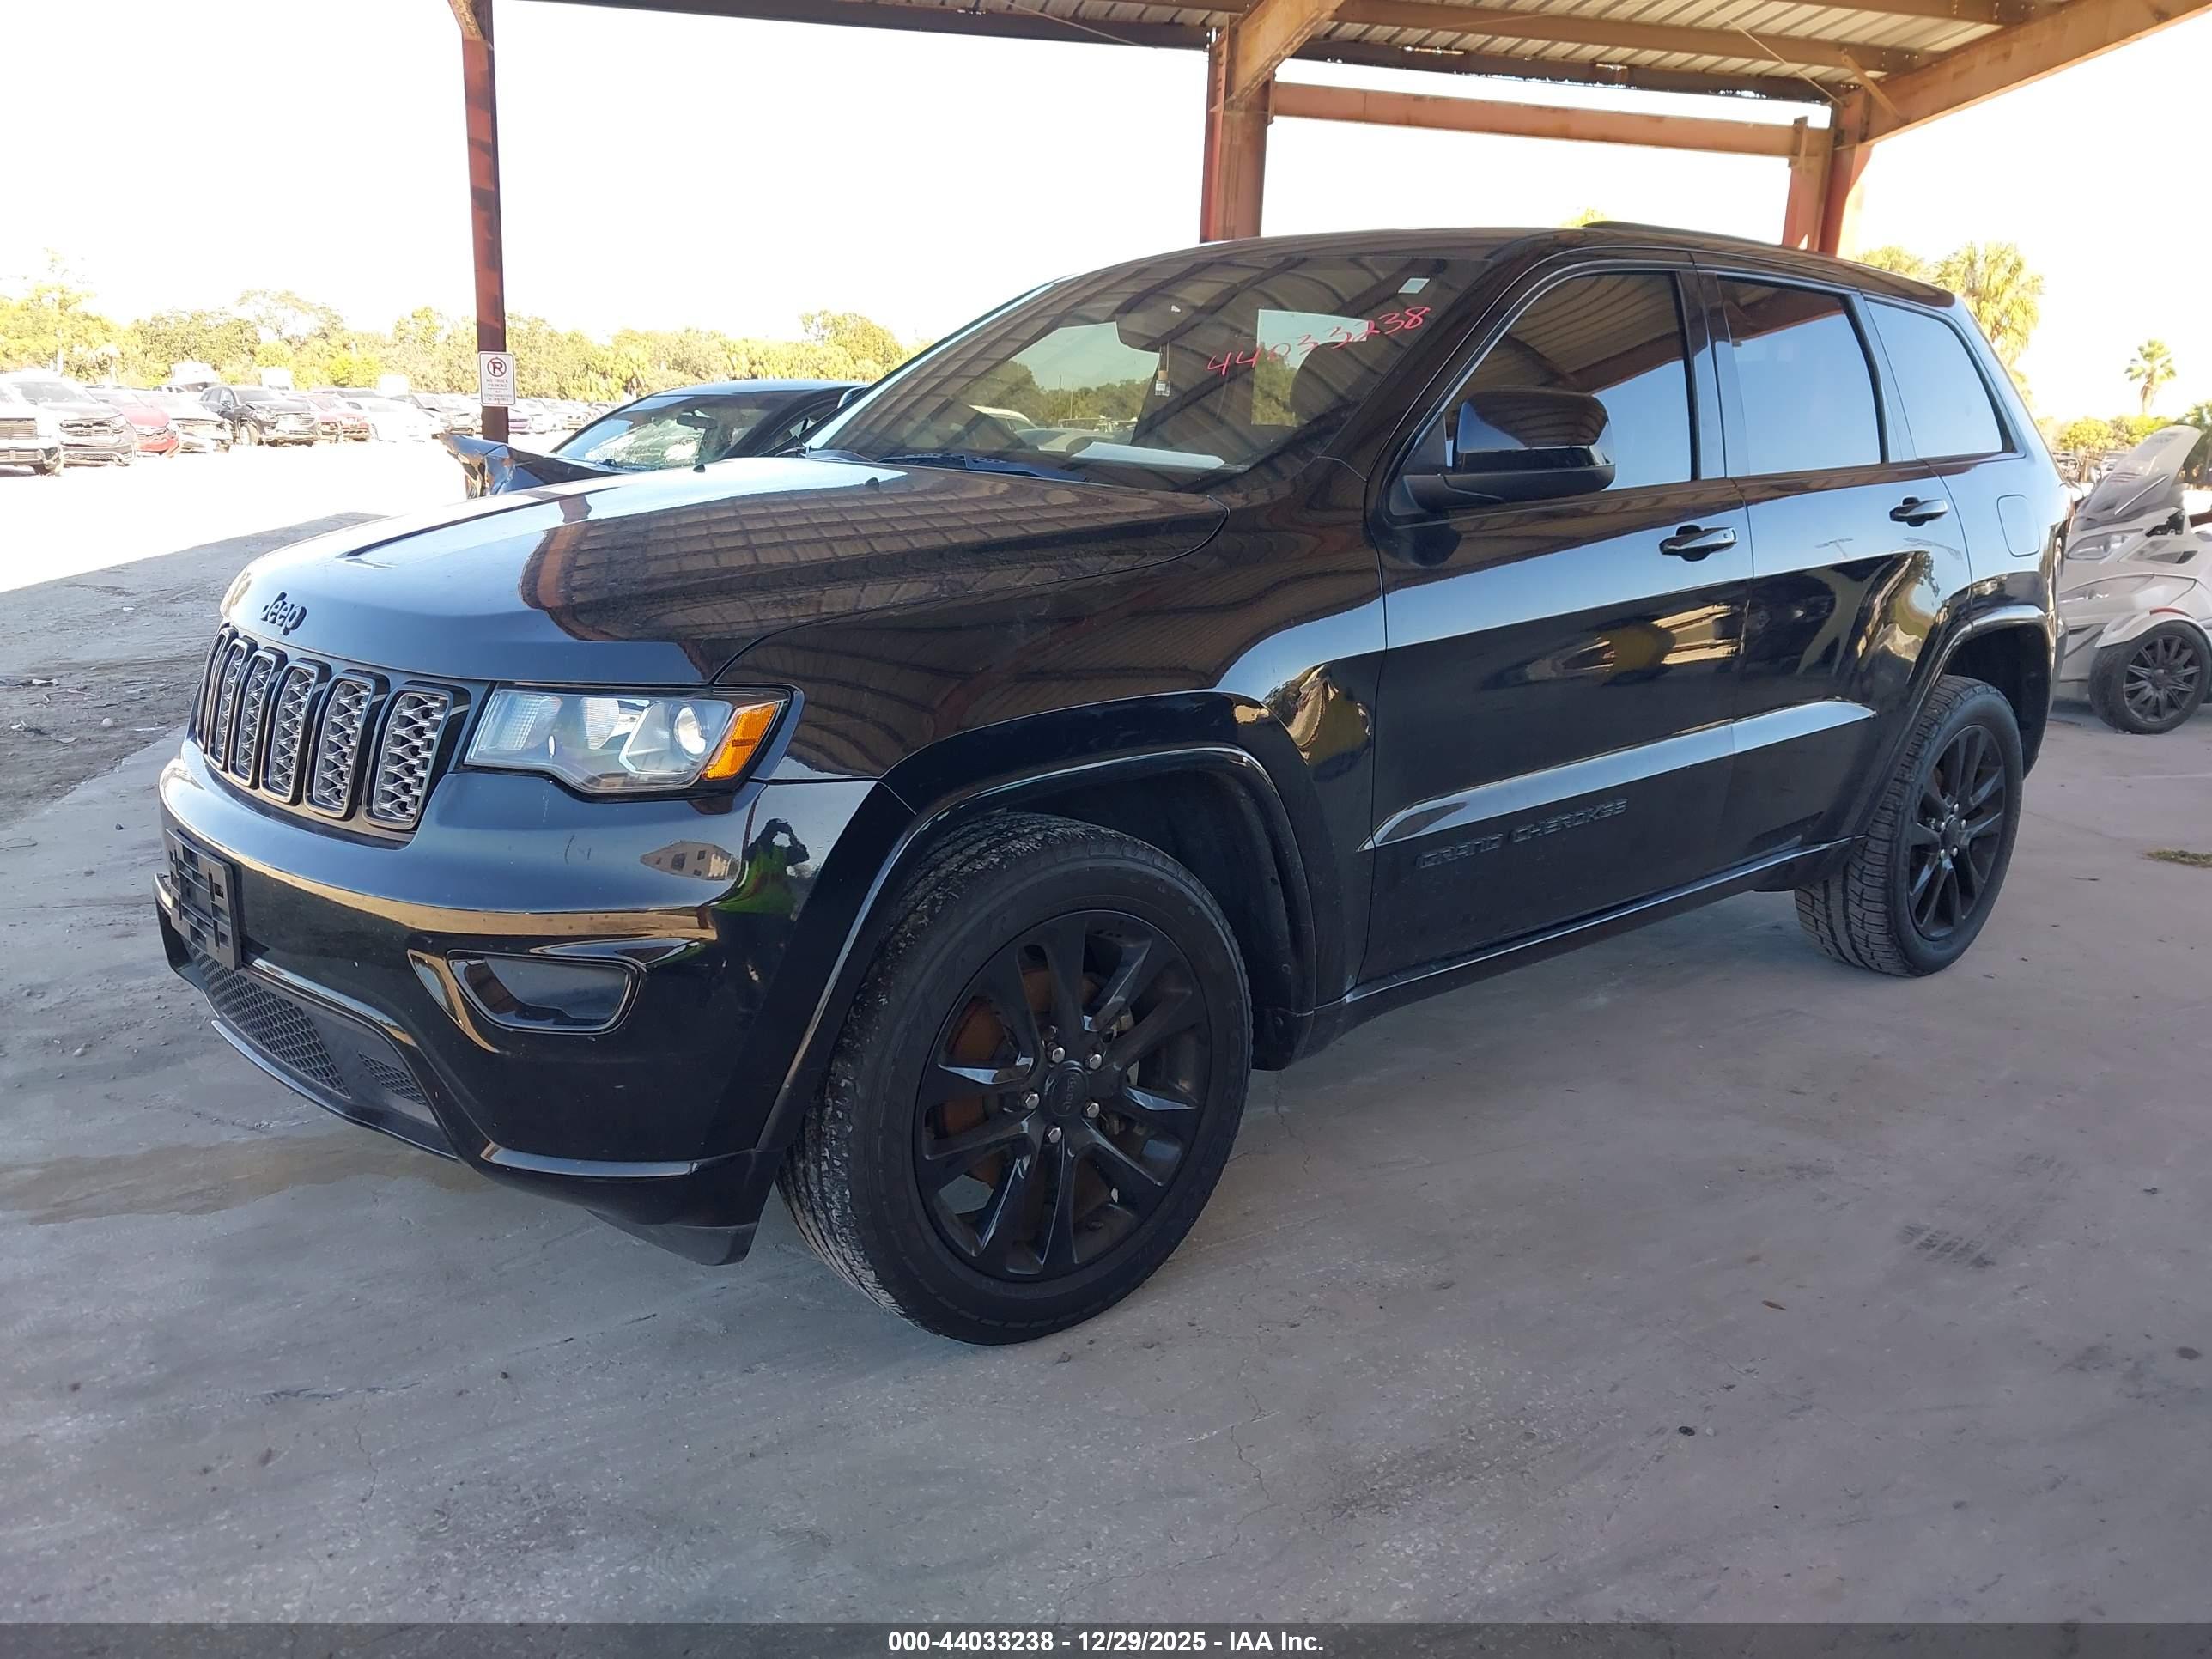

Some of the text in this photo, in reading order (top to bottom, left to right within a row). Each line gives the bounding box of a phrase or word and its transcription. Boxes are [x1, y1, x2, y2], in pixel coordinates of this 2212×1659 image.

[1206, 306, 1431, 376] 44033238
[260, 592, 307, 636] Jeep
[1415, 798, 1629, 869] GRAND CHEROKEE
